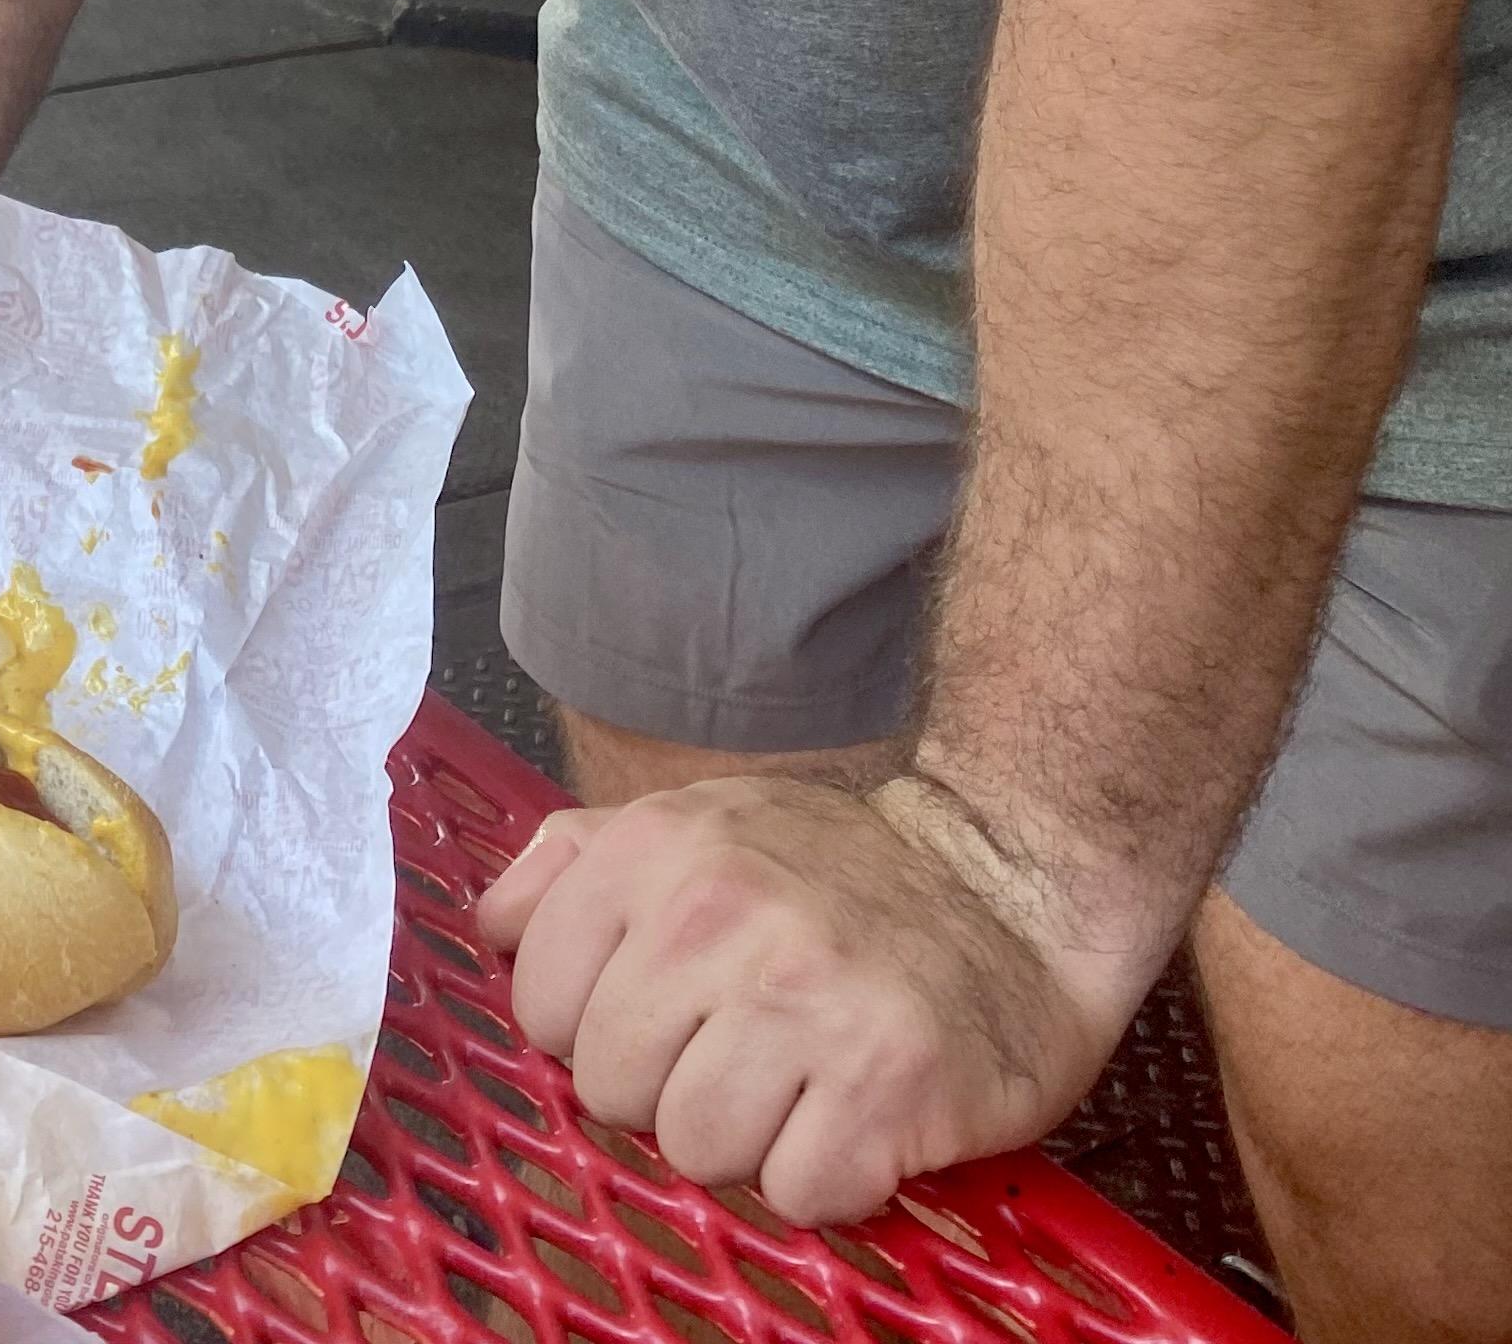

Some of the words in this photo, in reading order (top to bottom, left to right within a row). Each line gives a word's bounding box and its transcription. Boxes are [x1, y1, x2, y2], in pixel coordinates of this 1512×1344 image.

[81, 1173, 106, 1222] THANK
[24, 1207, 63, 1295] 215-468-
[73, 1222, 93, 1254] YOU
[61, 1254, 84, 1287] FOR
[53, 1289, 73, 1312] YOU
